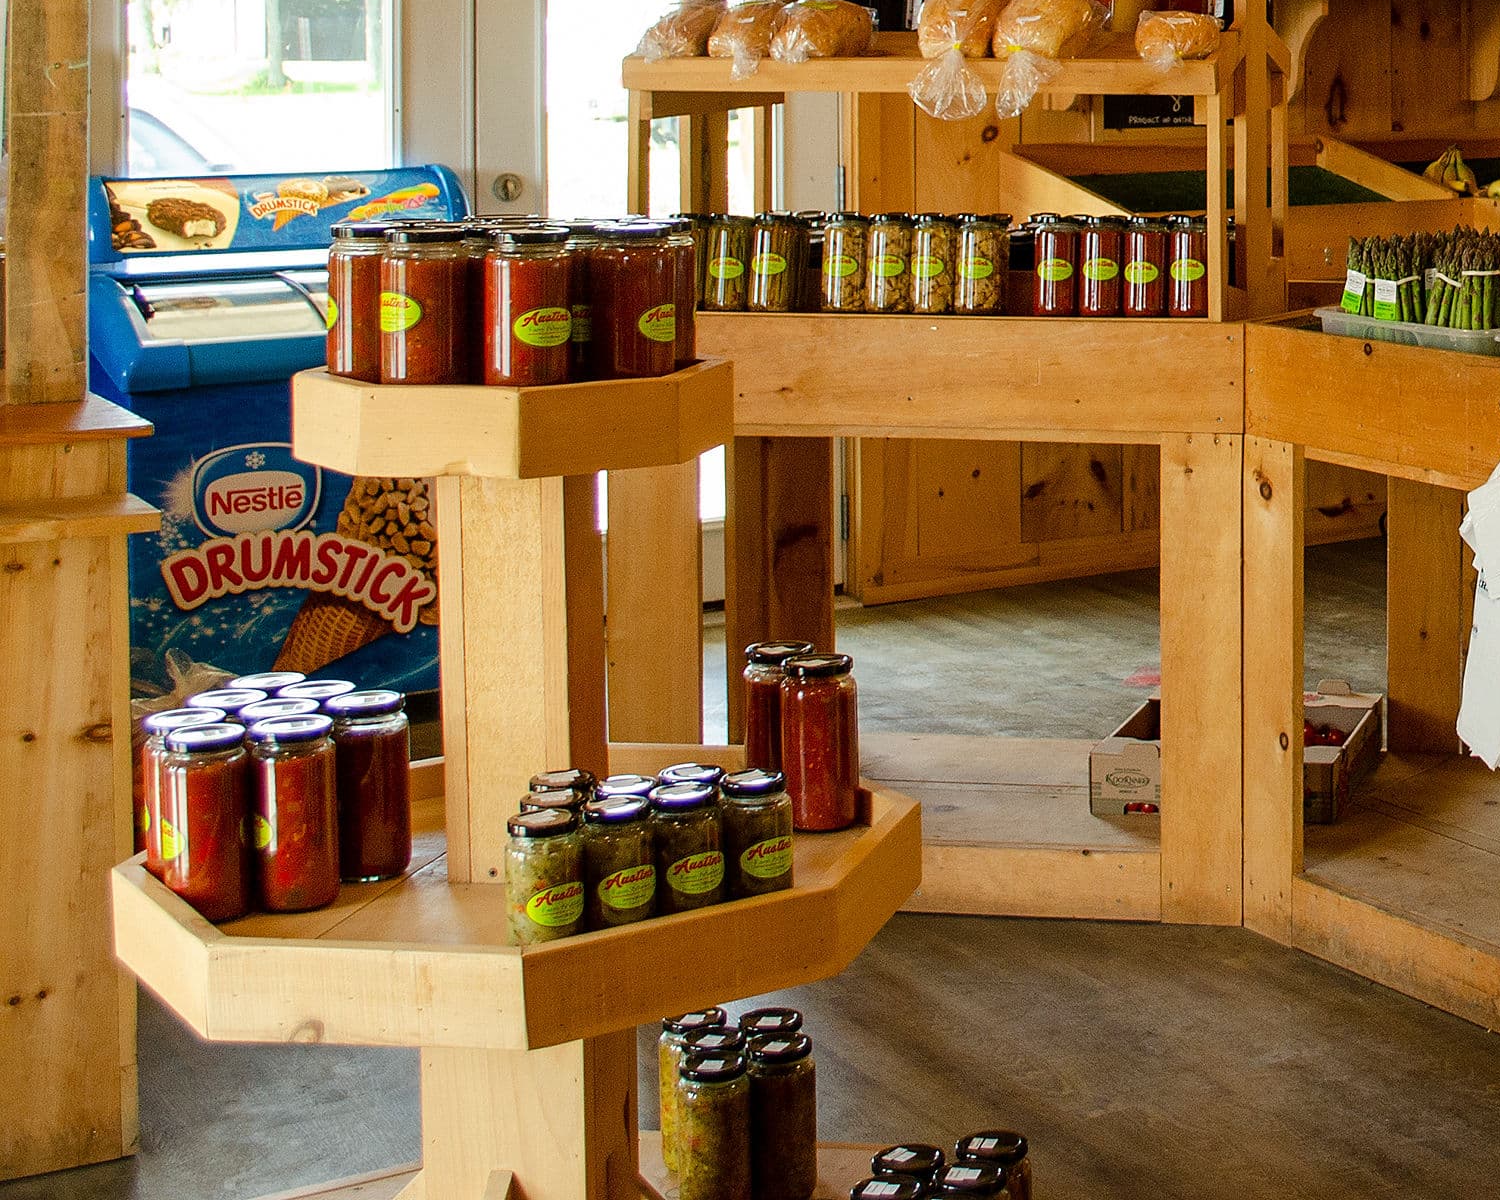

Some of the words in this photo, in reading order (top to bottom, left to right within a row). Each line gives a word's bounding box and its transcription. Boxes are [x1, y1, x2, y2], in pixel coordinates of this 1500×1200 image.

[252, 199, 317, 217] DRUMSTICK
[211, 484, 302, 516] Nestlé
[170, 537, 430, 626] DRUMSTICK
